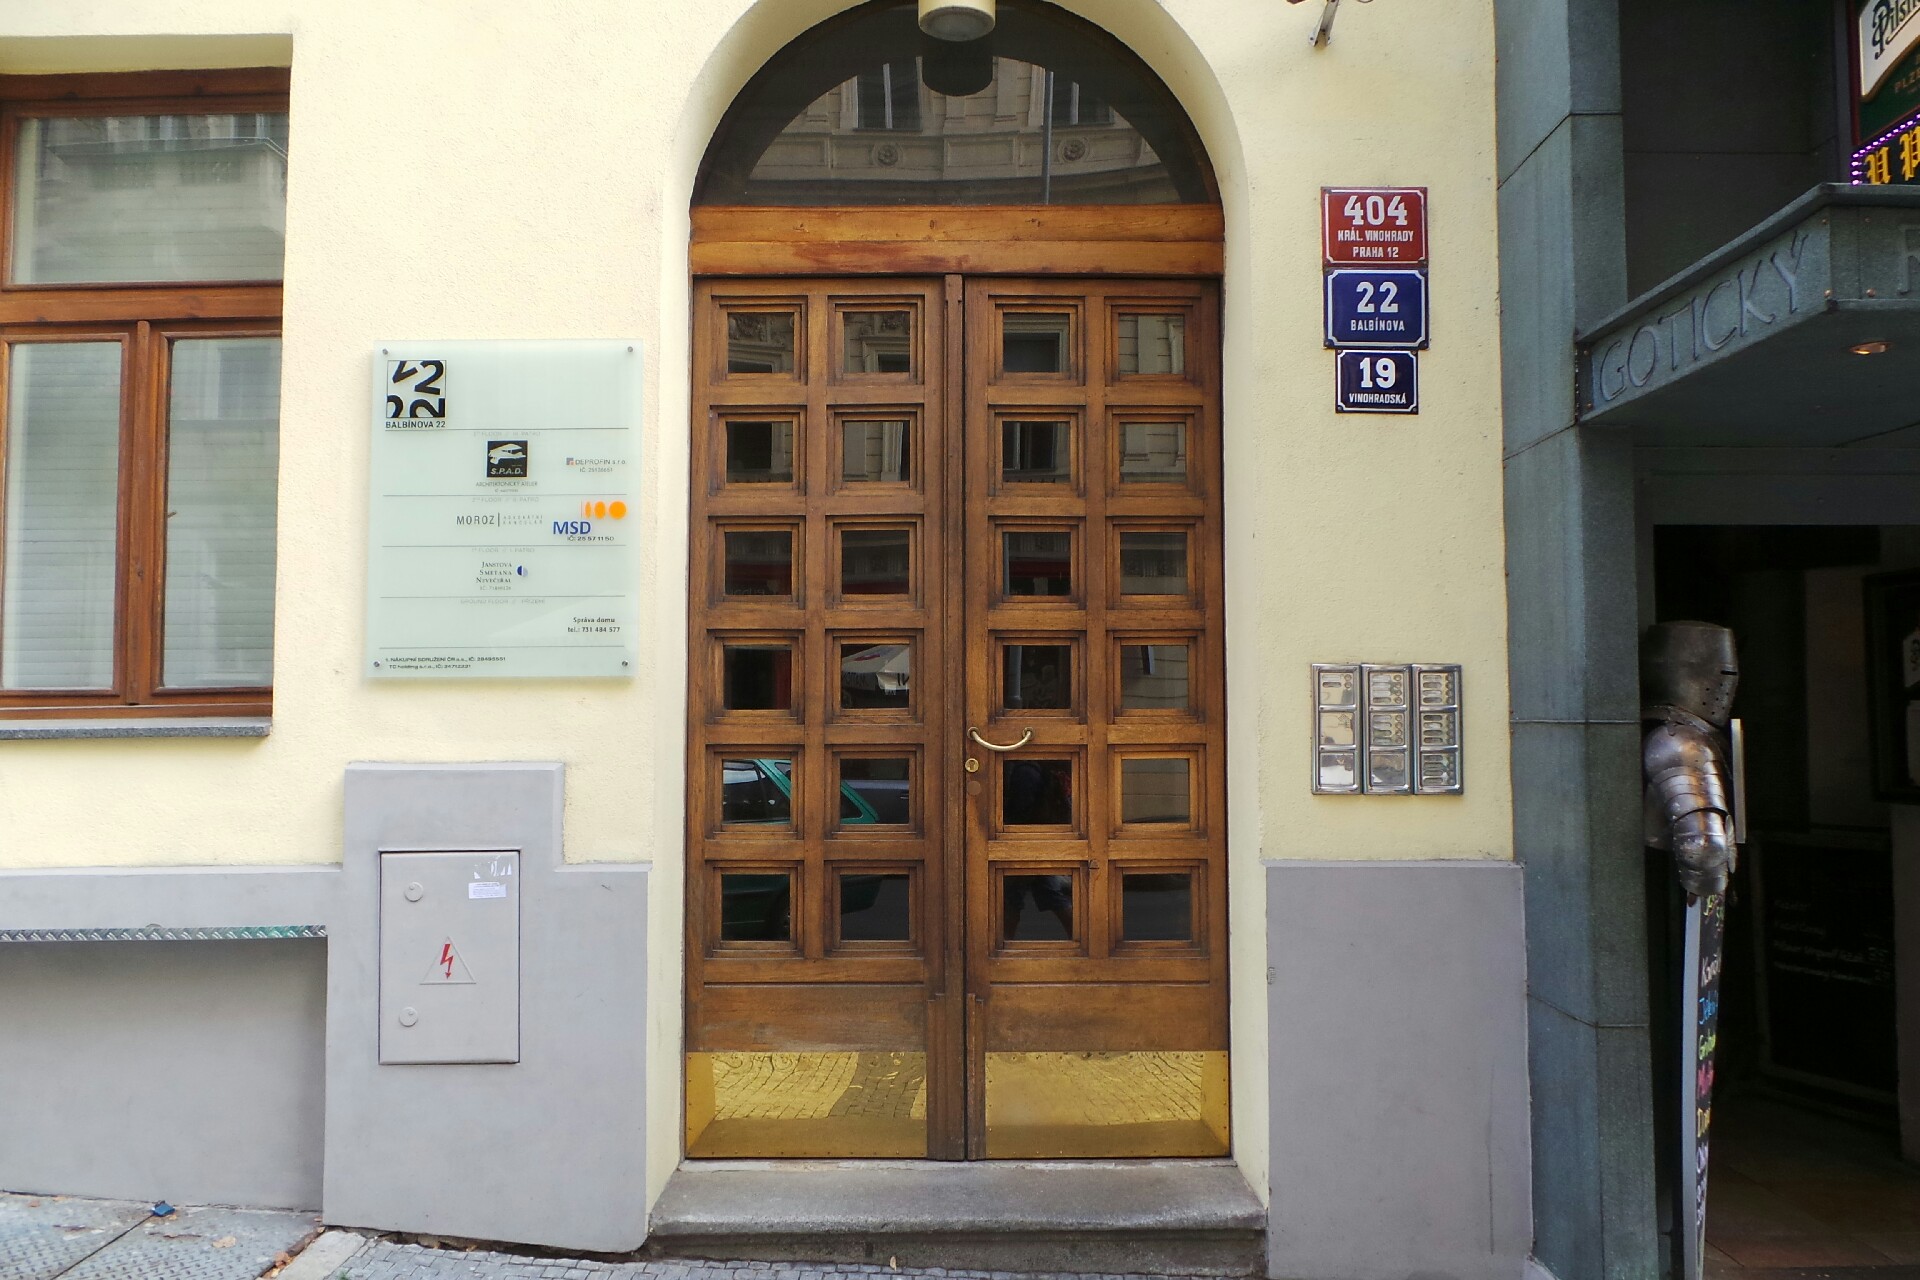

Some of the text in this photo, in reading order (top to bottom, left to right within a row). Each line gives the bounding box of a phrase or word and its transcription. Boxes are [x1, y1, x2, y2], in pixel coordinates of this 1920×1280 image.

[1344, 195, 1408, 226] 404
[1337, 227, 1414, 242] KRÁL. VINOHRADY
[1352, 246, 1399, 258] PRAHA 12
[1355, 281, 1399, 313] 22
[1350, 317, 1405, 331] BALBÍNOVA
[1359, 357, 1396, 389] 19
[1348, 391, 1407, 404] VINOHRADSKÁ
[385, 420, 446, 428] BALBÍNOVA 22
[490, 467, 523, 475] S.P.A.D.
[456, 515, 495, 525] MOROZ
[553, 521, 591, 535] MSD
